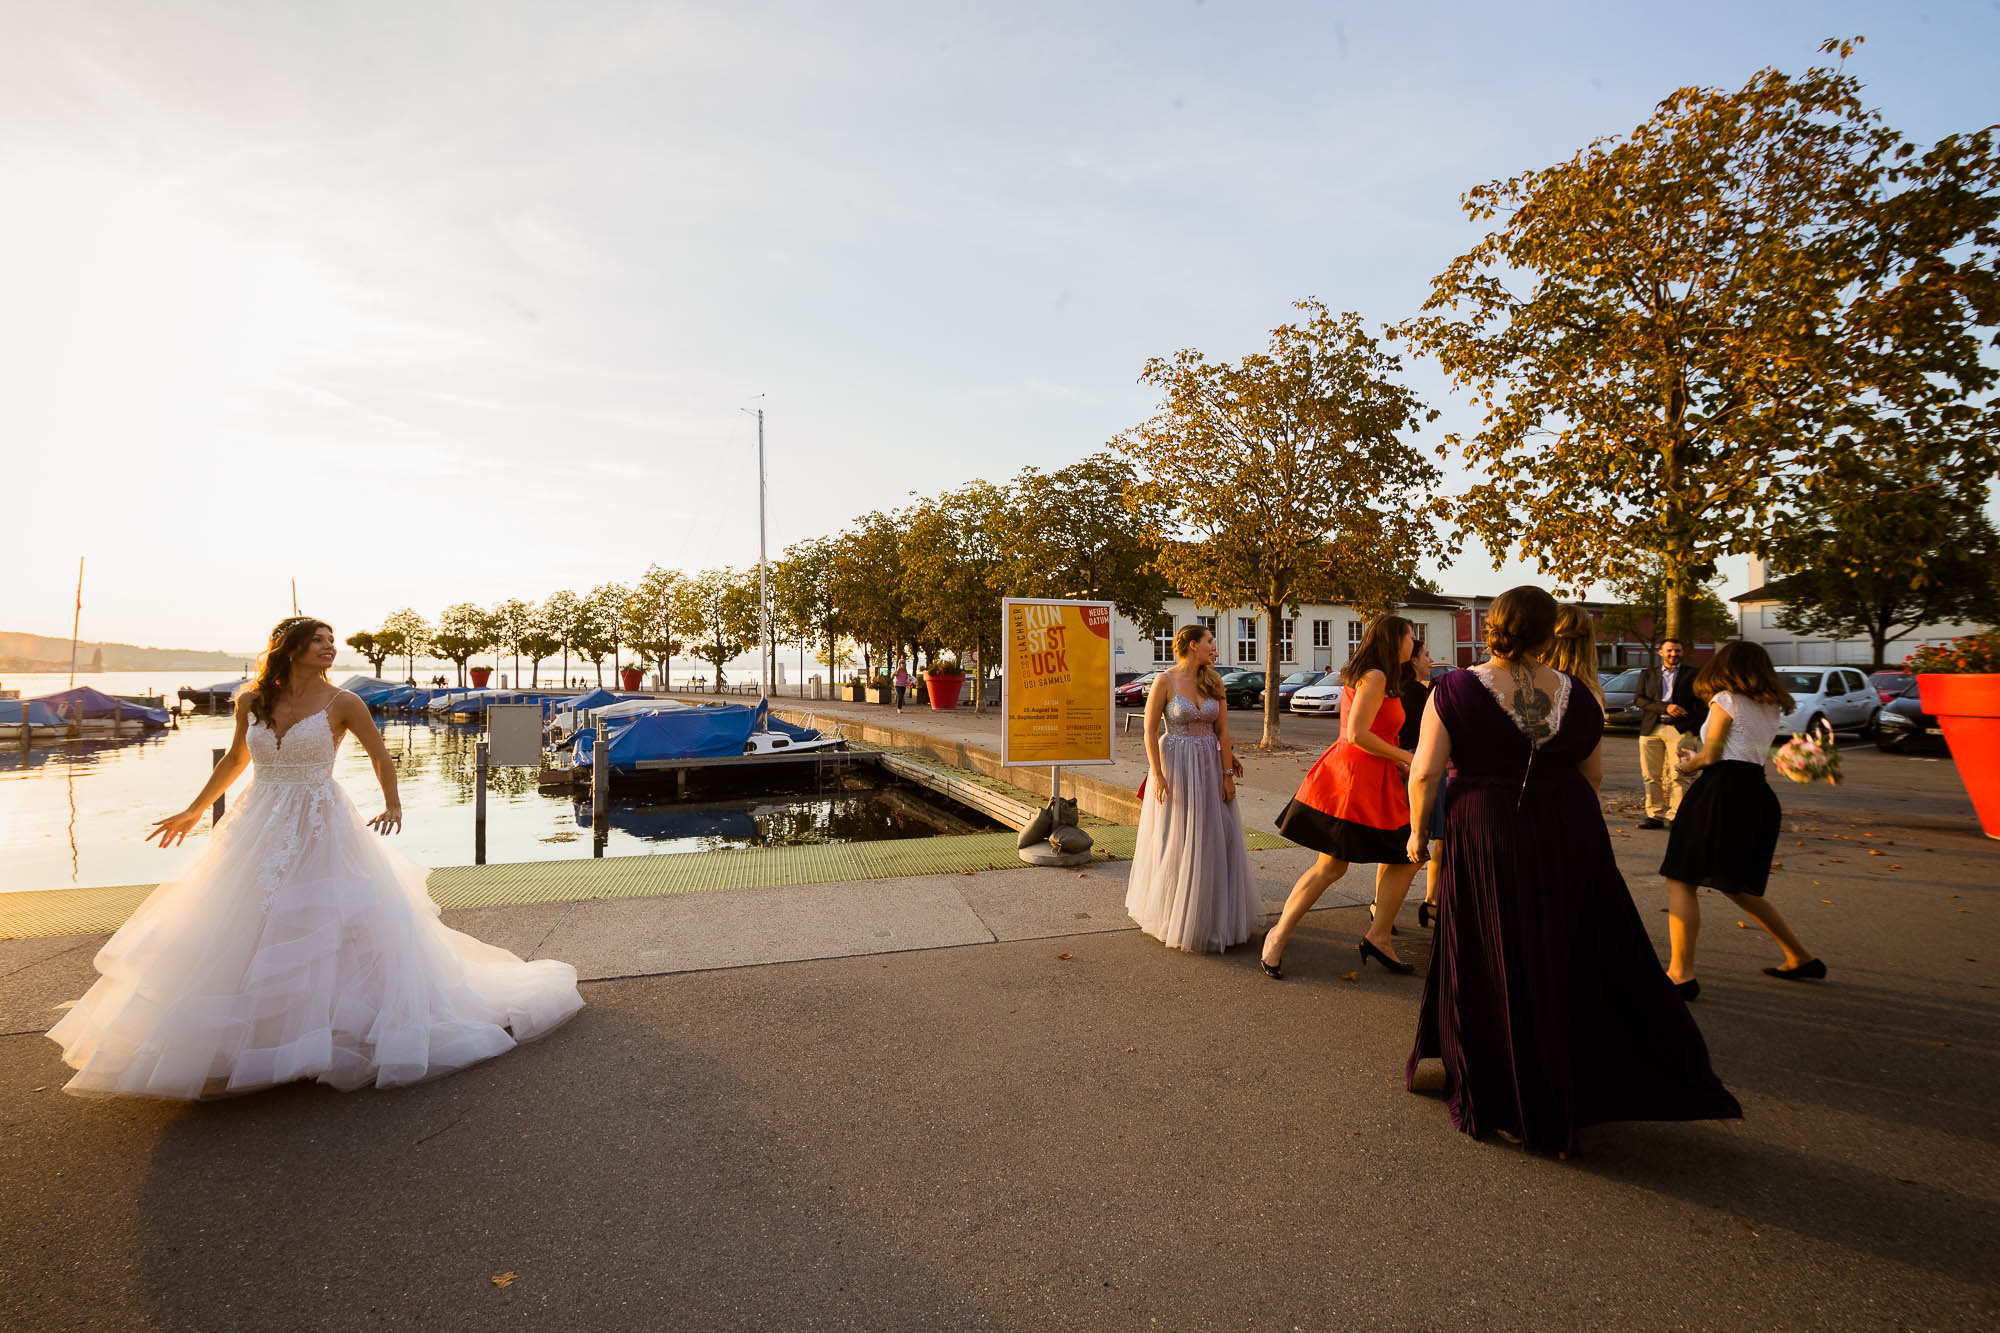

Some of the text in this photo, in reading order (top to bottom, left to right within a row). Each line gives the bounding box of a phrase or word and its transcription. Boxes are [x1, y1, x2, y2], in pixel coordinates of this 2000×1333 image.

[1025, 605, 1063, 630] KUN
[1088, 607, 1109, 617] NEUES
[1088, 616, 1110, 626] DATUM
[1013, 608, 1027, 652] LACHNER
